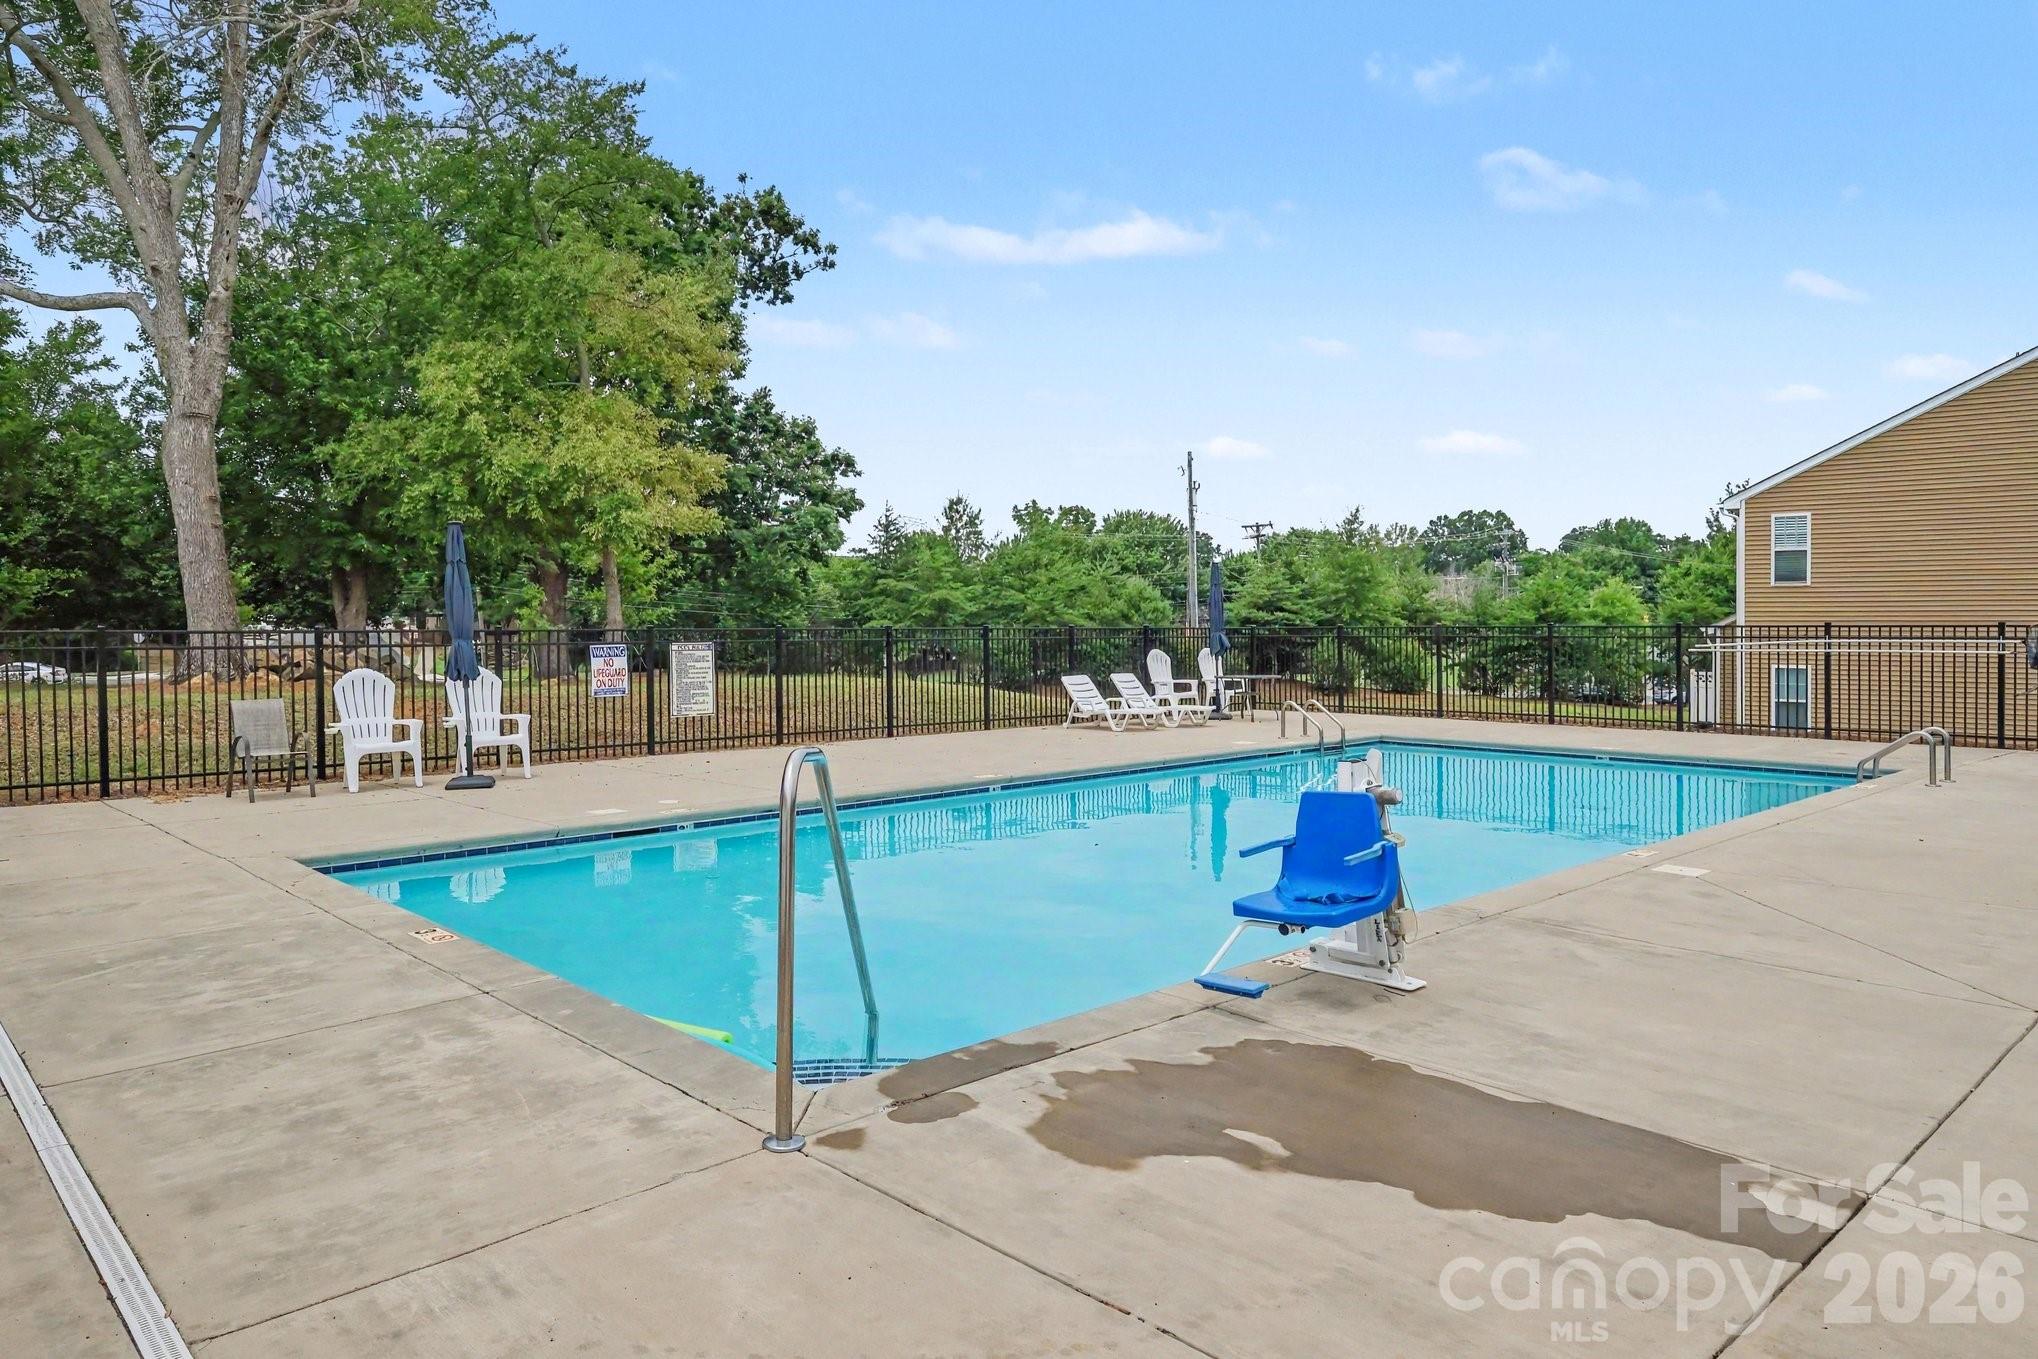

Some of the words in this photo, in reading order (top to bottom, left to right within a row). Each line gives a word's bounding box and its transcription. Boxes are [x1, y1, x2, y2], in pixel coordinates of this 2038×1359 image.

[592, 647, 625, 657] WARNING
[603, 658, 614, 667] NO
[594, 668, 626, 678] LIFEGUARD
[596, 679, 606, 688] ON
[608, 678, 625, 687] DUTY
